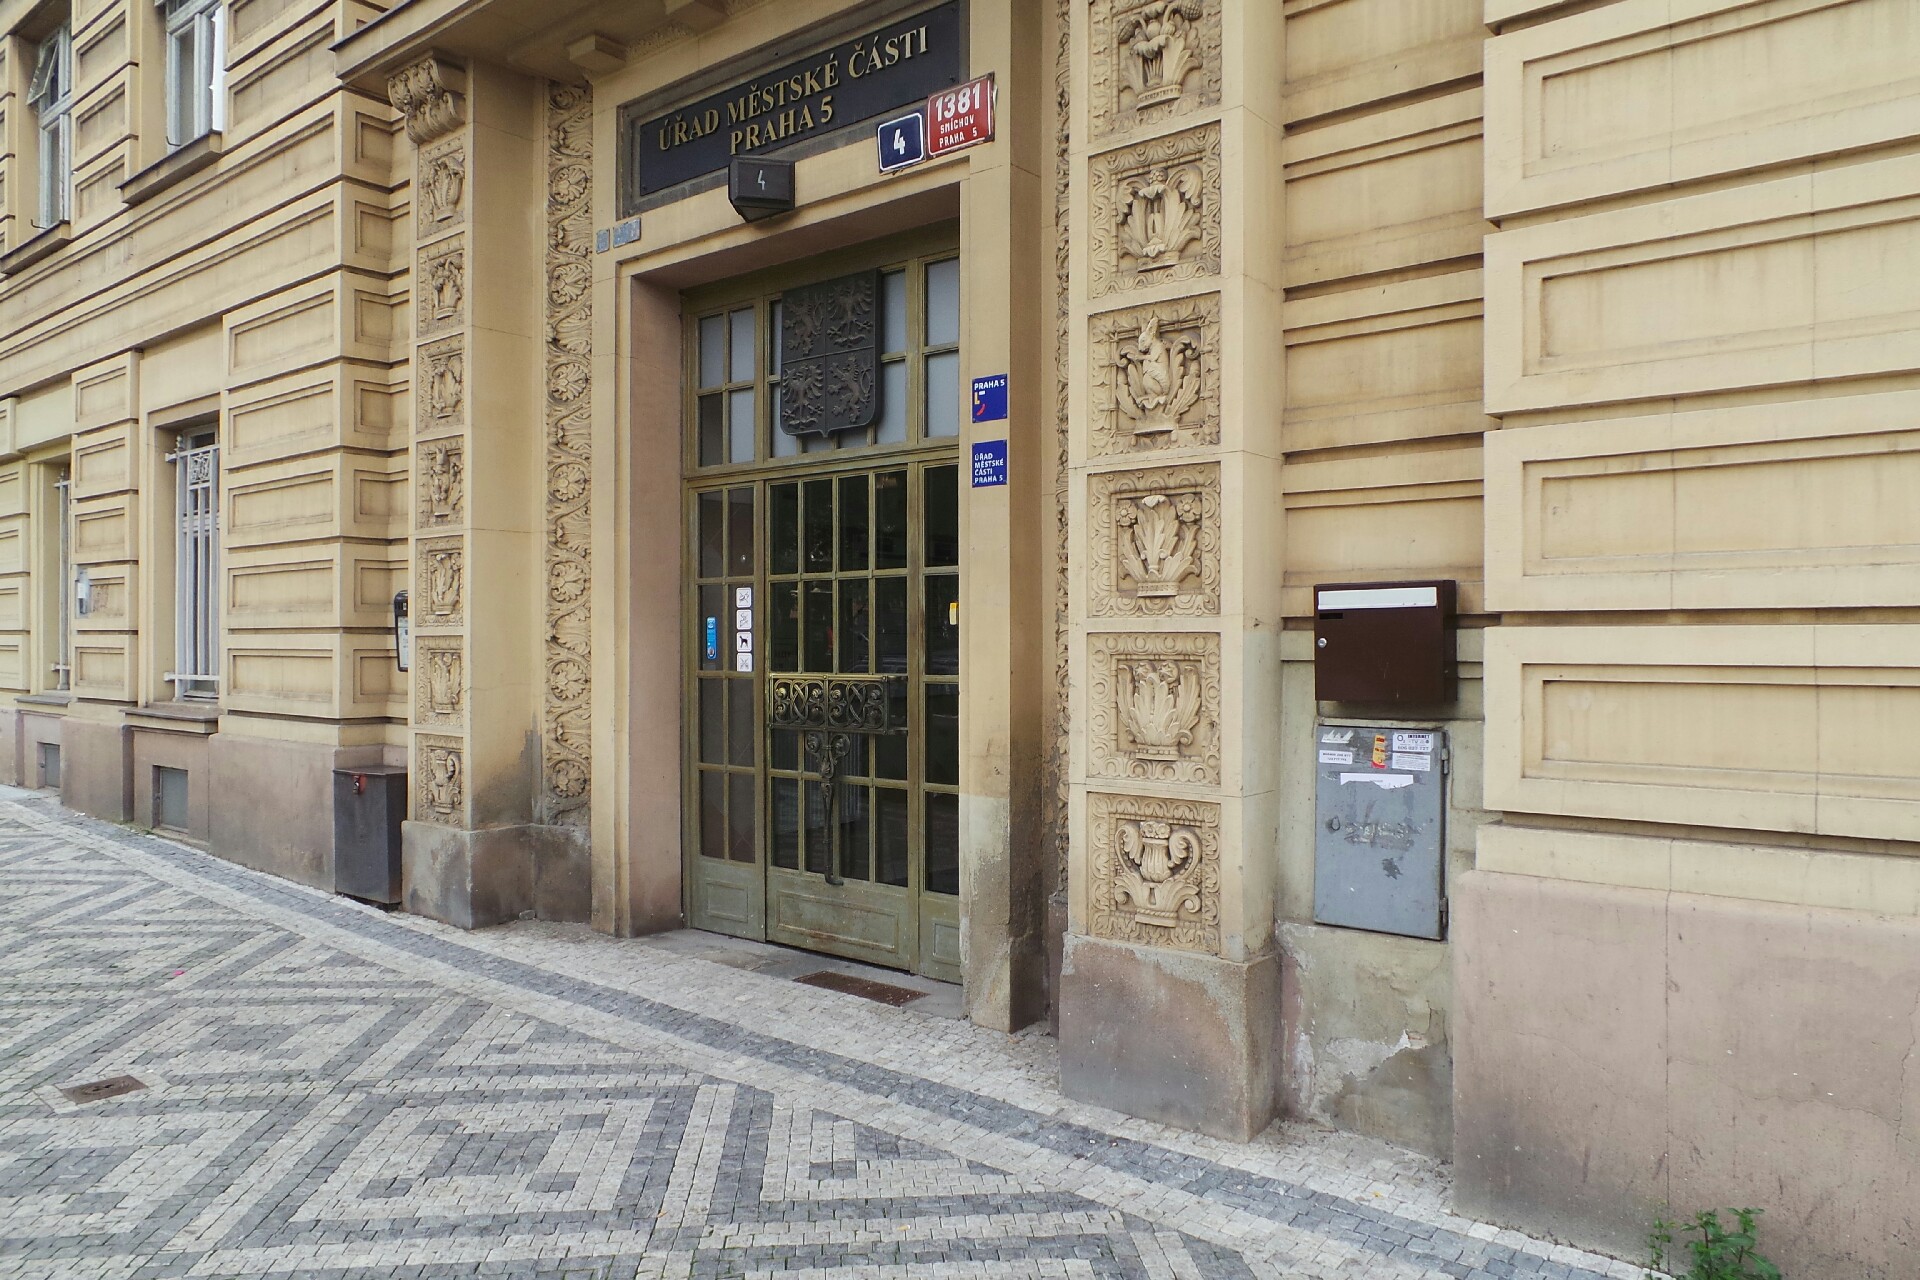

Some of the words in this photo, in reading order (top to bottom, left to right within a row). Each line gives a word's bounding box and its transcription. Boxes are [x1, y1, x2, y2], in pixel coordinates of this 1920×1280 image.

[658, 109, 720, 152] ÚŘAD
[726, 53, 839, 128] MĚSTSKÉ
[847, 25, 929, 79] ČÁSTI
[935, 82, 981, 122] 1381
[729, 103, 815, 156] PRAHA
[819, 95, 834, 124] 5
[940, 114, 975, 135] SMÍCHOV
[893, 128, 906, 155] 4
[939, 131, 965, 148] PRAHA
[972, 126, 978, 137] 5
[756, 169, 767, 191] 4
[974, 380, 999, 391] PRAHA
[1000, 378, 1006, 387] 5
[974, 452, 993, 461] ÚŘAD
[974, 457, 1004, 469] MĚSTSKÉ
[974, 475, 997, 484] PRAHA
[999, 474, 1004, 482] 5
